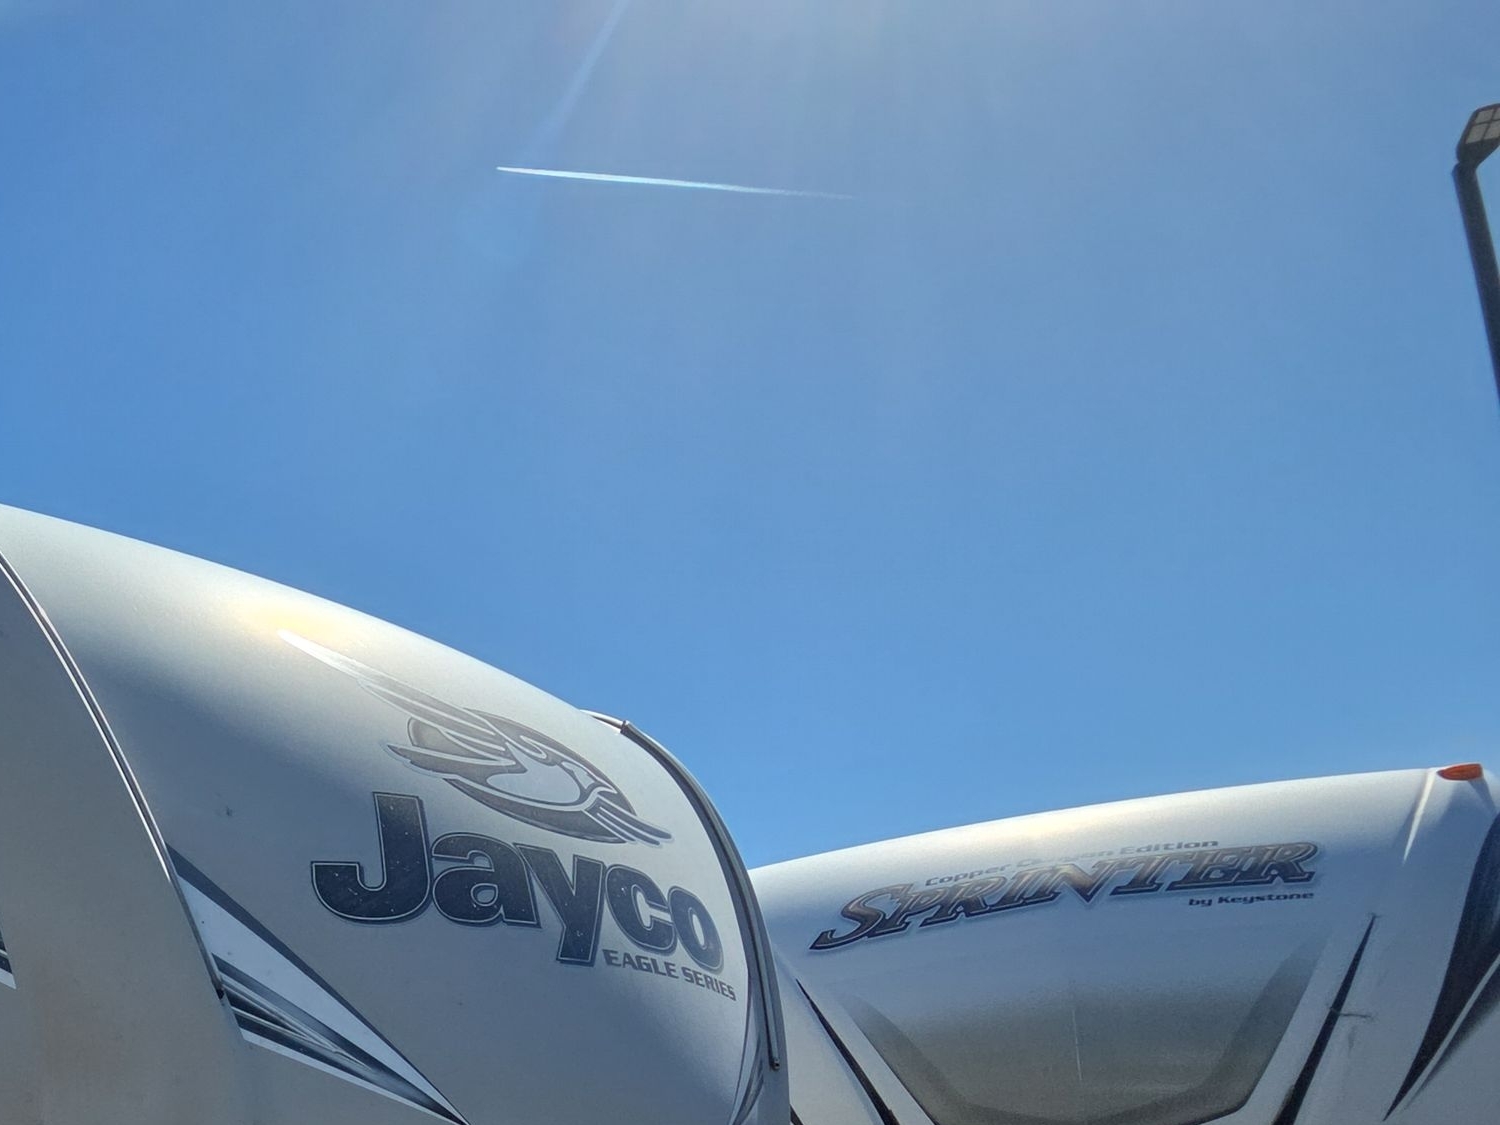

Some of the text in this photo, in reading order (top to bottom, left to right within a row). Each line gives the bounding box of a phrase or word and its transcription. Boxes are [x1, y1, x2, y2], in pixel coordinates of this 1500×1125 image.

[311, 792, 725, 967] Jayco
[924, 862, 1012, 887] Copper
[1119, 839, 1220, 856] Edition
[808, 841, 1321, 952] SPRINTER
[1188, 892, 1315, 907] by Keystone
[602, 949, 737, 1002] EAGLE SERIES
